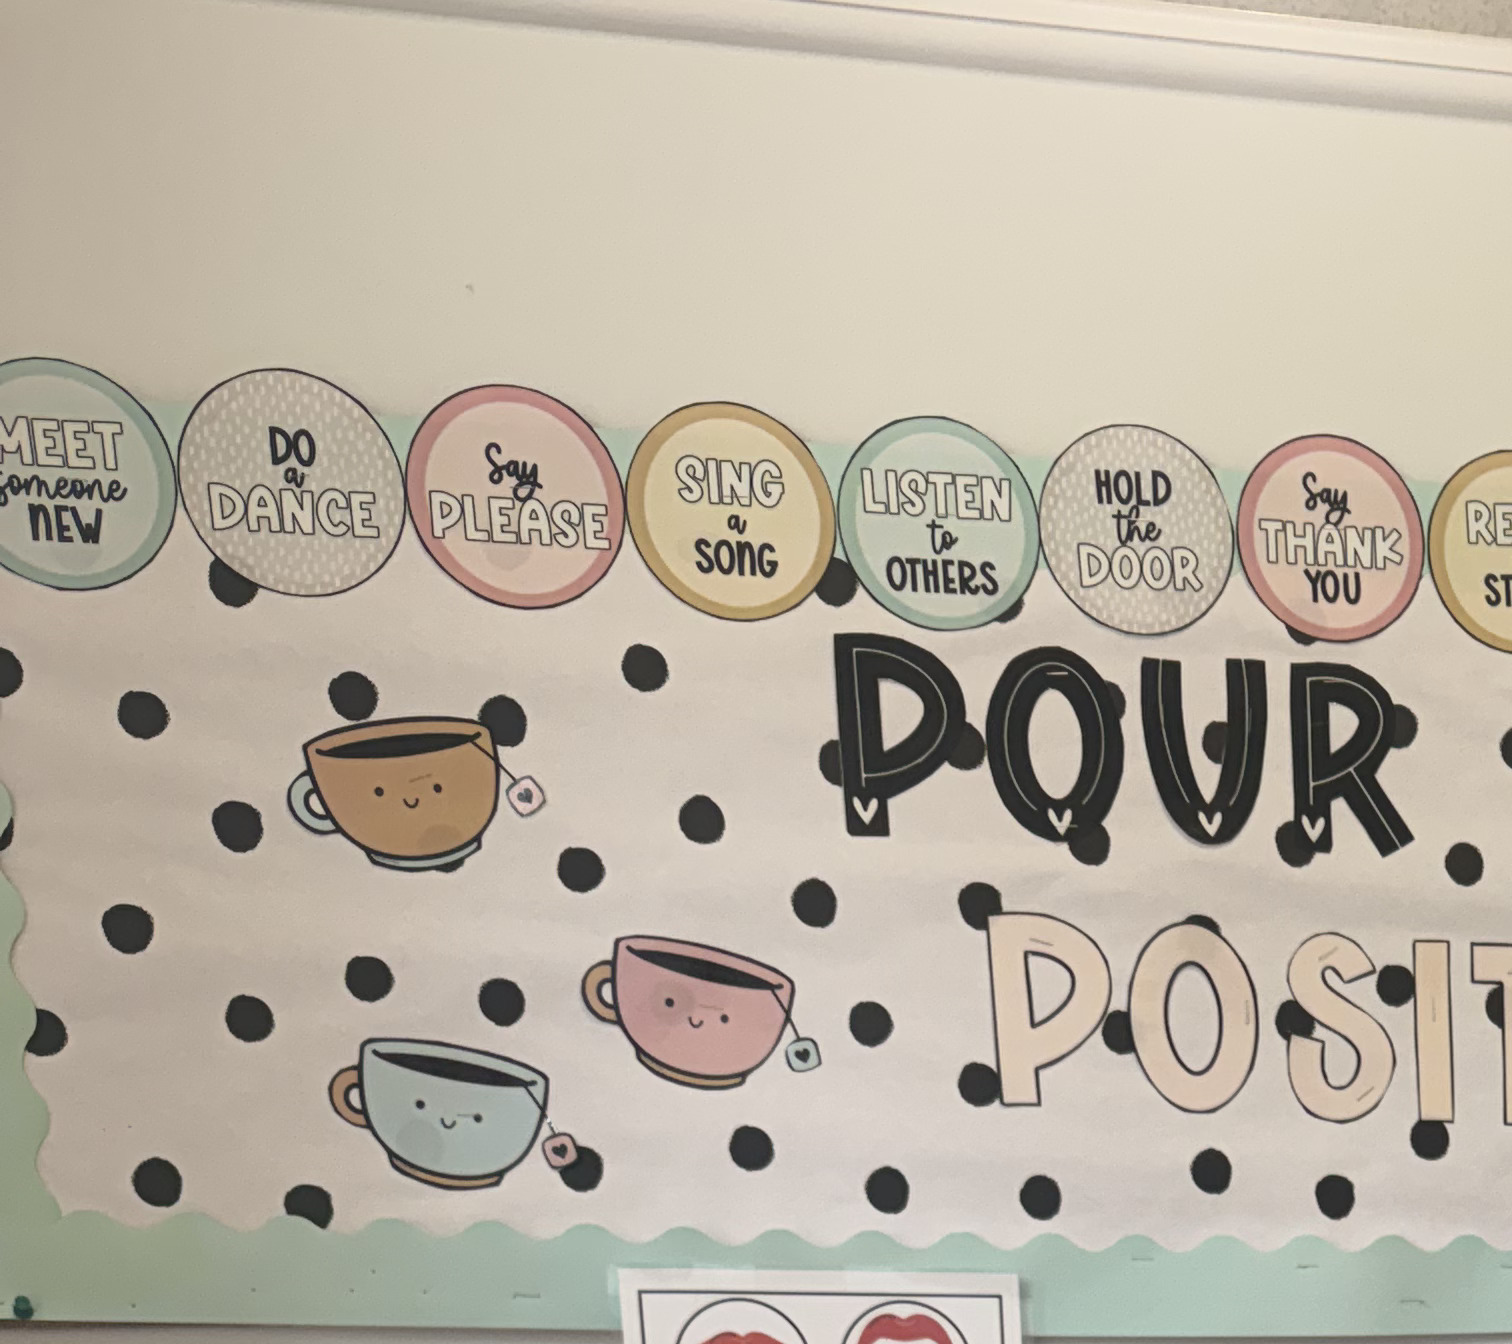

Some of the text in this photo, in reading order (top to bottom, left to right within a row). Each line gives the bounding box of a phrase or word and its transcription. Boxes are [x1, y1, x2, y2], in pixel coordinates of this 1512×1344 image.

[0, 416, 124, 471] MEET
[268, 426, 316, 467] DO
[284, 467, 305, 488] a
[485, 442, 542, 499] Say
[675, 455, 785, 509] SING
[860, 468, 1012, 522] LISTEN
[1094, 469, 1172, 507] HOLD
[208, 483, 380, 539] DANCE
[429, 491, 611, 551] PLEASE
[1302, 471, 1351, 522] Say
[727, 513, 747, 535] a
[926, 518, 959, 551] to
[1117, 505, 1162, 544] the
[1258, 519, 1403, 571] THANK
[694, 538, 779, 578] SONG
[886, 557, 999, 595] OTHERS
[1077, 543, 1203, 592] DOOR
[1303, 568, 1362, 605] YOU
[834, 632, 1416, 859] POUR
